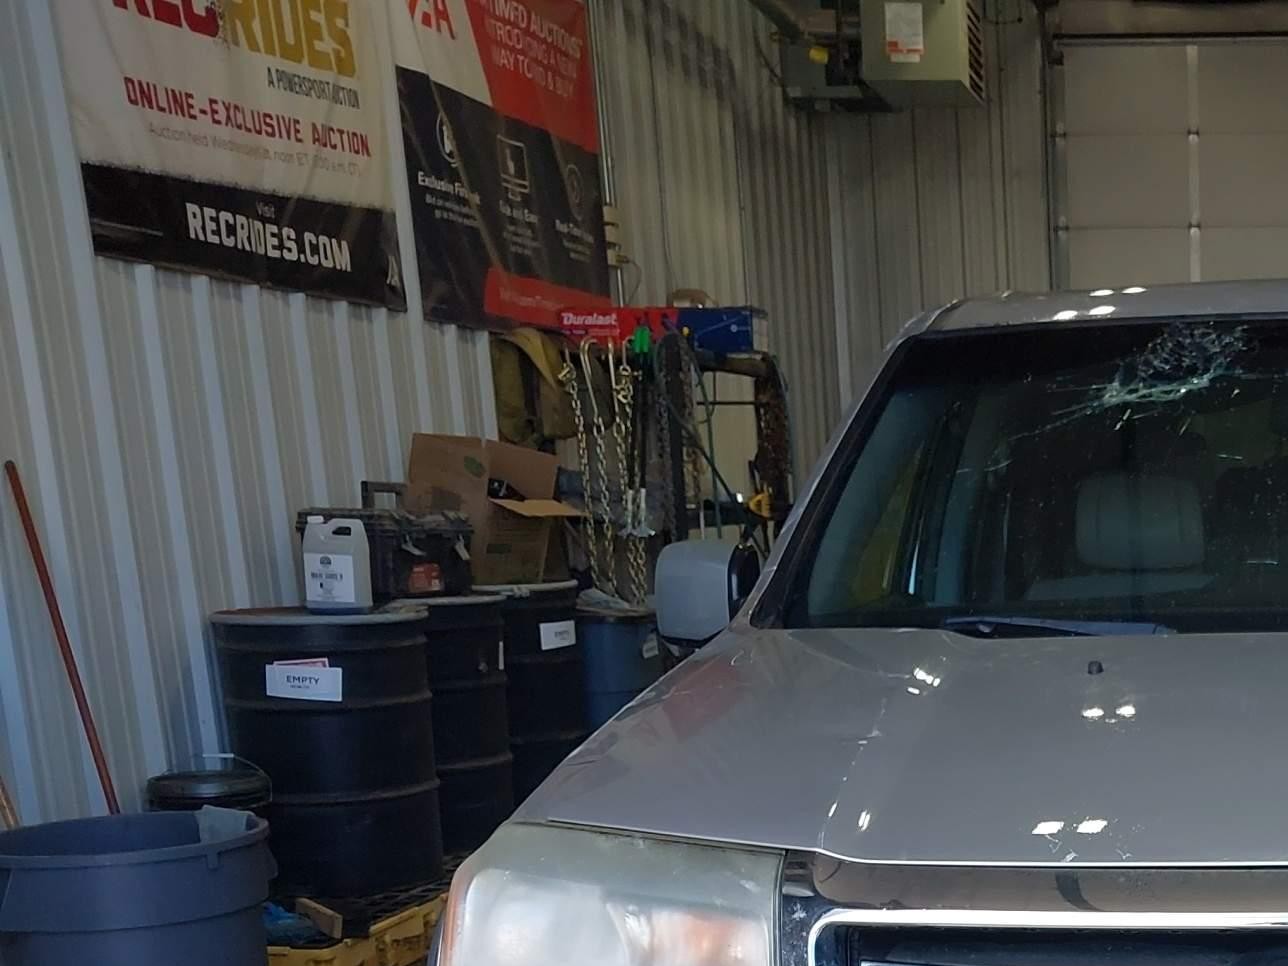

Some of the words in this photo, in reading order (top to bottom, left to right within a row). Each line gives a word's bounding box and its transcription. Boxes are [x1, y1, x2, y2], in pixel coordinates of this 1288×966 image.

[267, 66, 276, 89] A
[123, 76, 304, 143] ONLINE-EXCLUSIVE
[311, 122, 372, 158] AUCTION
[256, 200, 275, 219] Visit
[185, 202, 352, 273] RECRIDES.COM
[561, 312, 618, 326] Duralast
[286, 674, 320, 686] EMPTY
